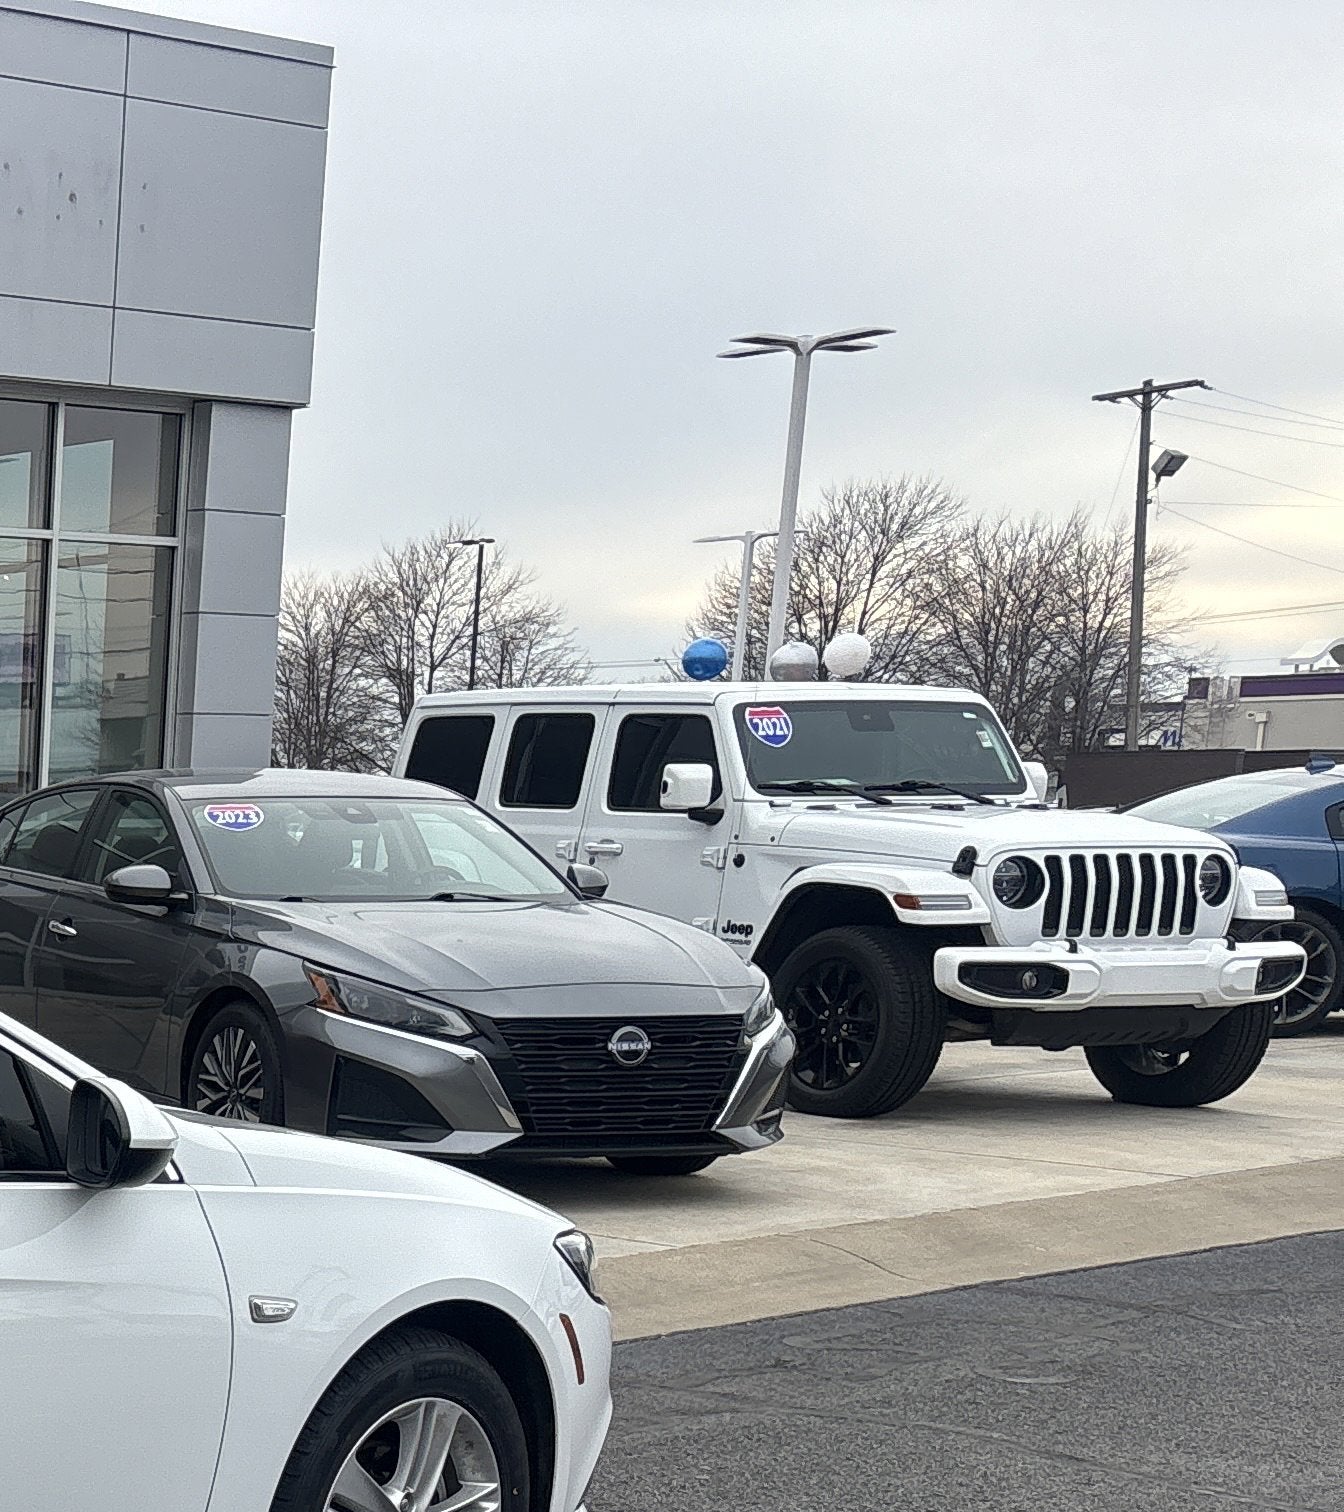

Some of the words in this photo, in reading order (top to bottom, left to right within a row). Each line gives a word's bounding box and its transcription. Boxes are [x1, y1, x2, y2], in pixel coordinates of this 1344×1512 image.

[752, 717, 789, 736] 2021
[213, 811, 258, 823] 2023
[721, 919, 754, 938] Jeep
[607, 1040, 652, 1051] NISSAN
